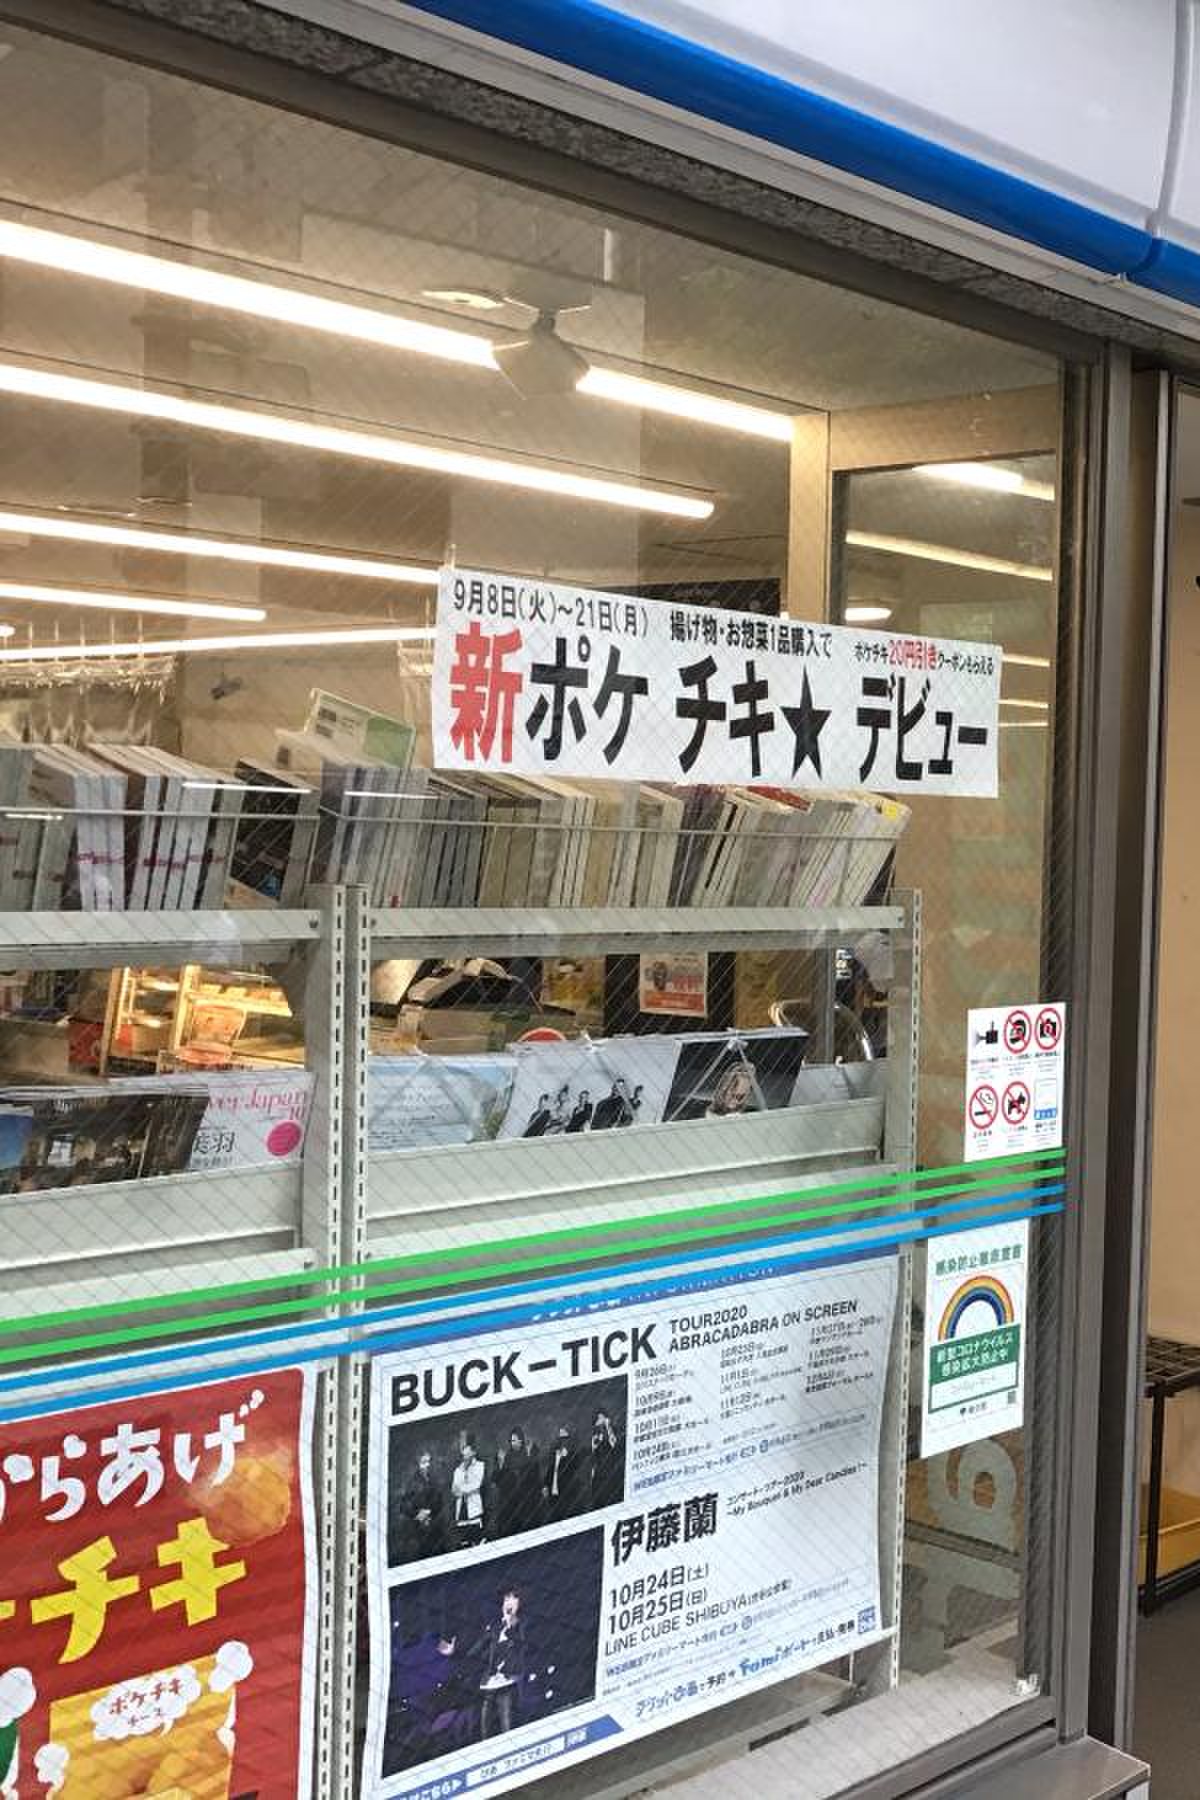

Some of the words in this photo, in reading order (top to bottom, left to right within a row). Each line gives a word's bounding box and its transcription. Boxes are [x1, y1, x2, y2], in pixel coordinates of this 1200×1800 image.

[669, 1304, 748, 1335] TOUR2020
[669, 1318, 779, 1353] ABRACADABRA
[782, 1311, 801, 1328] ON
[803, 1299, 858, 1322] SCREEN
[611, 1492, 719, 1568] 伊藤蘭
[610, 1563, 710, 1610] 10月24日(土)
[608, 1588, 708, 1635] 10月25日(日)
[604, 1631, 638, 1657] LINE
[640, 1616, 681, 1644] CUBE
[109, 1677, 182, 1716] ポケチキ
